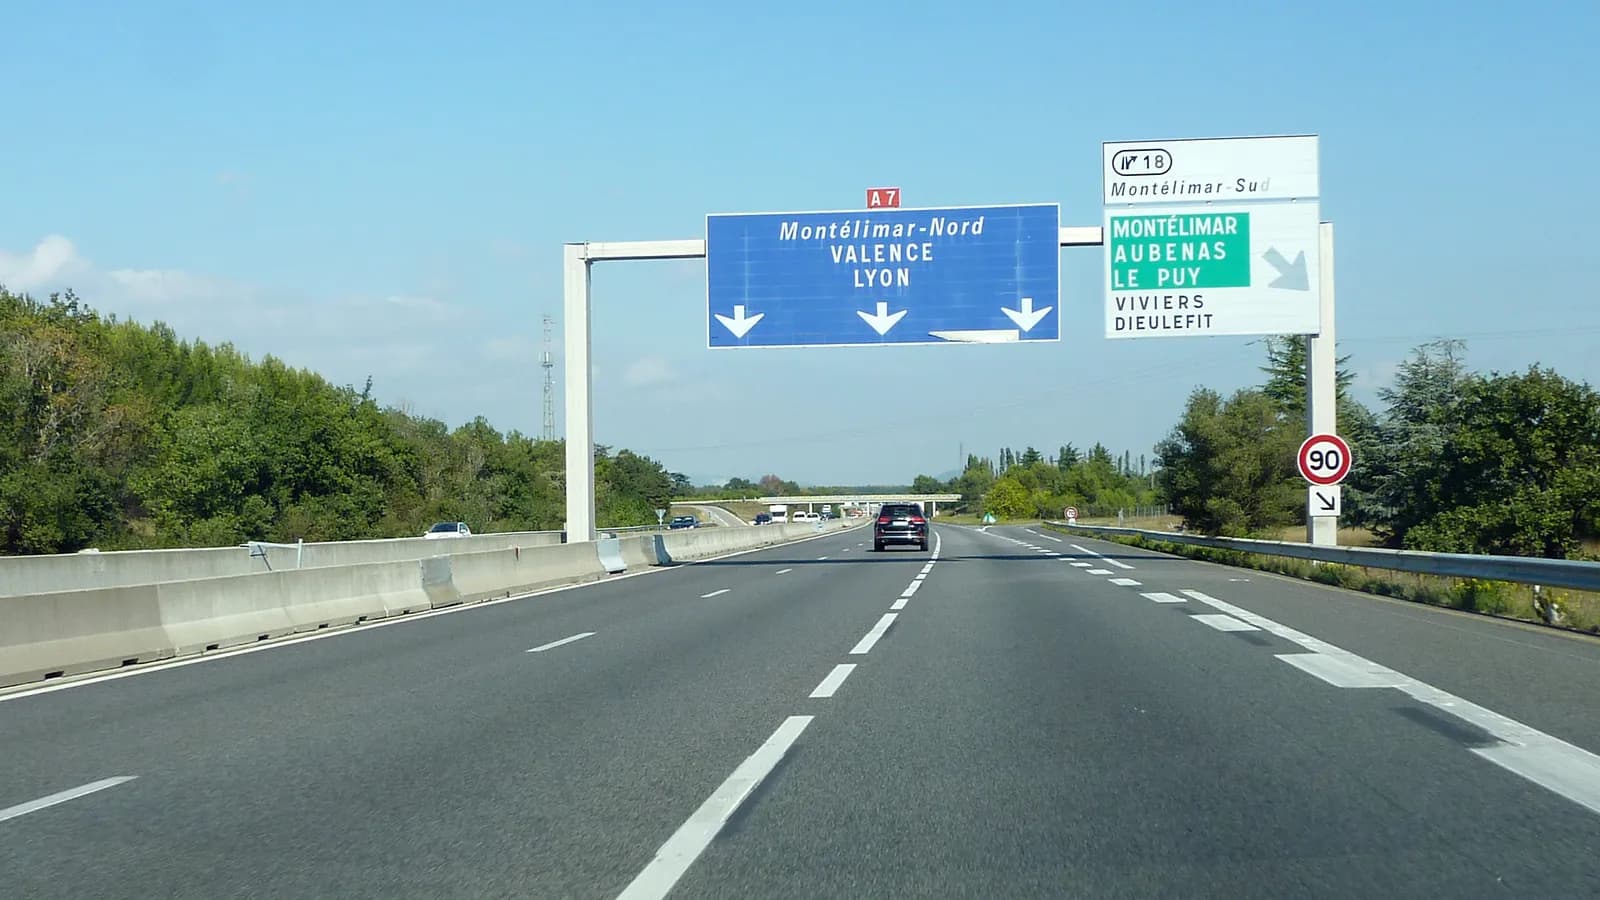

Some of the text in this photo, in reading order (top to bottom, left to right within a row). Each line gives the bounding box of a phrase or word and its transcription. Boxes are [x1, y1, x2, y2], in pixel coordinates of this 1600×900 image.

[1143, 155, 1164, 169] 18
[871, 191, 896, 206] A 7
[779, 216, 985, 240] Montélimar-Nord
[1113, 215, 1237, 238] MONTÉLIMAR
[831, 243, 933, 263] VALENCE
[1115, 242, 1226, 262] AUBENAS
[854, 268, 910, 288] LYON
[1115, 268, 1200, 287] LE PUY
[1116, 295, 1204, 311] VIVIERS
[1115, 314, 1213, 331] DIEULEFIT
[1310, 450, 1339, 470] 90
